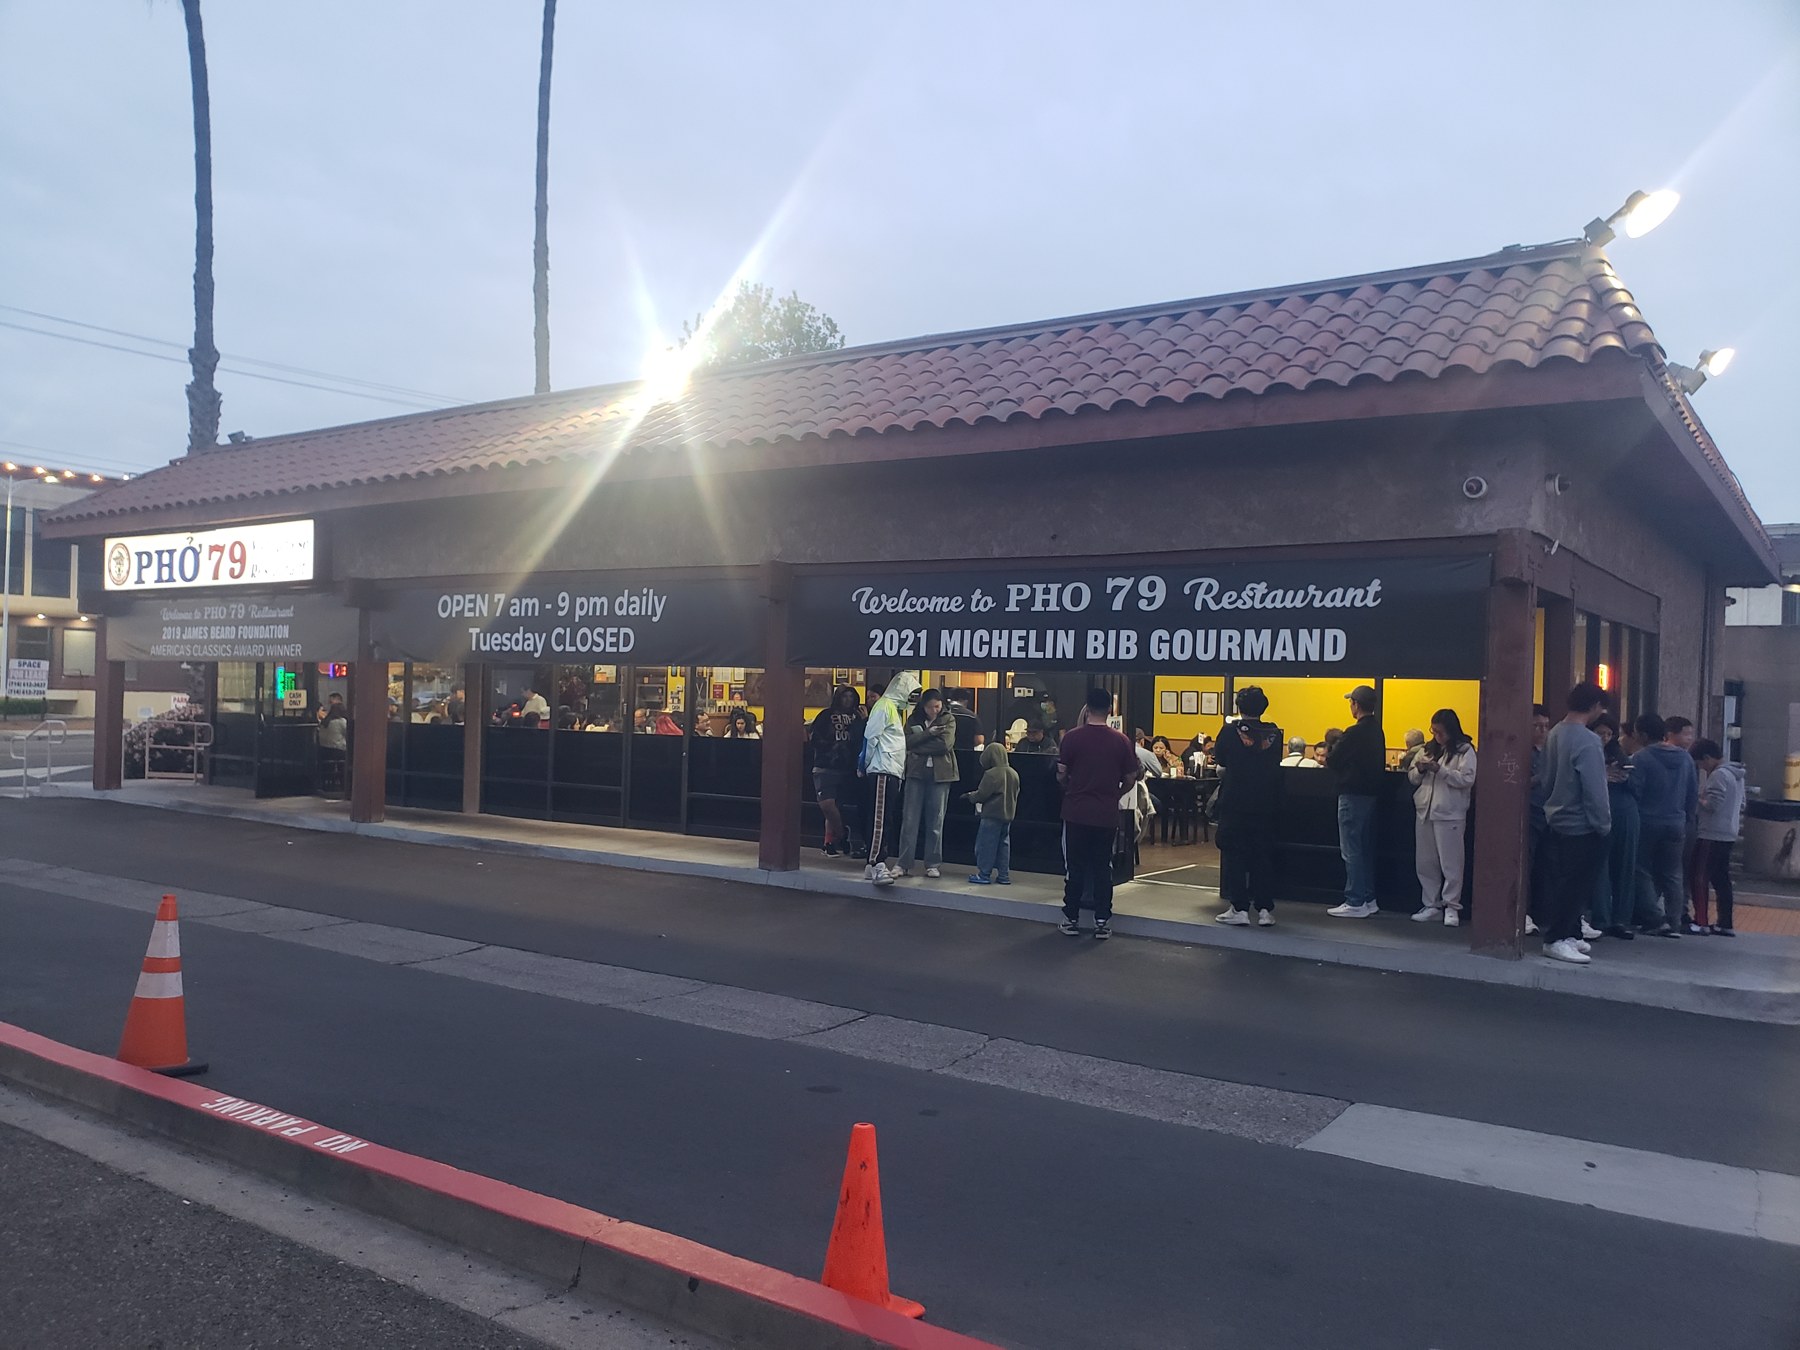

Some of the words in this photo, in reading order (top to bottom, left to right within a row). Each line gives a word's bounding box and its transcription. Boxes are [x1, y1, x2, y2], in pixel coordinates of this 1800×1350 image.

[208, 540, 247, 581] 79
[437, 593, 489, 618] OPEN
[493, 593, 506, 617] 7
[509, 597, 540, 617] am
[557, 591, 570, 617] 9
[574, 595, 609, 622] pm
[614, 587, 667, 622] daily
[851, 585, 965, 615] Welcome
[969, 589, 996, 613] to
[1004, 582, 1092, 613] PHO
[1105, 575, 1168, 610] 79
[1183, 577, 1382, 611] Restaurant
[160, 606, 193, 621] Welcome
[194, 609, 202, 620] to
[204, 605, 226, 620] PHO
[229, 603, 246, 619] 79
[249, 604, 294, 619] Restaurant
[162, 626, 181, 639] 2019
[182, 625, 208, 639] JAMES
[210, 625, 236, 639] BEARD
[238, 624, 289, 639] FOUNDATION
[468, 627, 546, 658] Tuesday
[550, 627, 635, 653] CLOSED
[867, 628, 928, 657] 2021
[938, 628, 1076, 660] MICHELIN
[1085, 628, 1138, 660] BIB
[1149, 628, 1348, 663] GOURMAND
[18, 660, 41, 669] SPACE
[150, 644, 192, 657] AMERICA'S
[192, 644, 232, 657] CLASSICS
[233, 644, 265, 657] AWARD
[266, 643, 302, 657] WINNER
[200, 1096, 319, 1137] PARKING
[314, 1134, 369, 1154] NO
